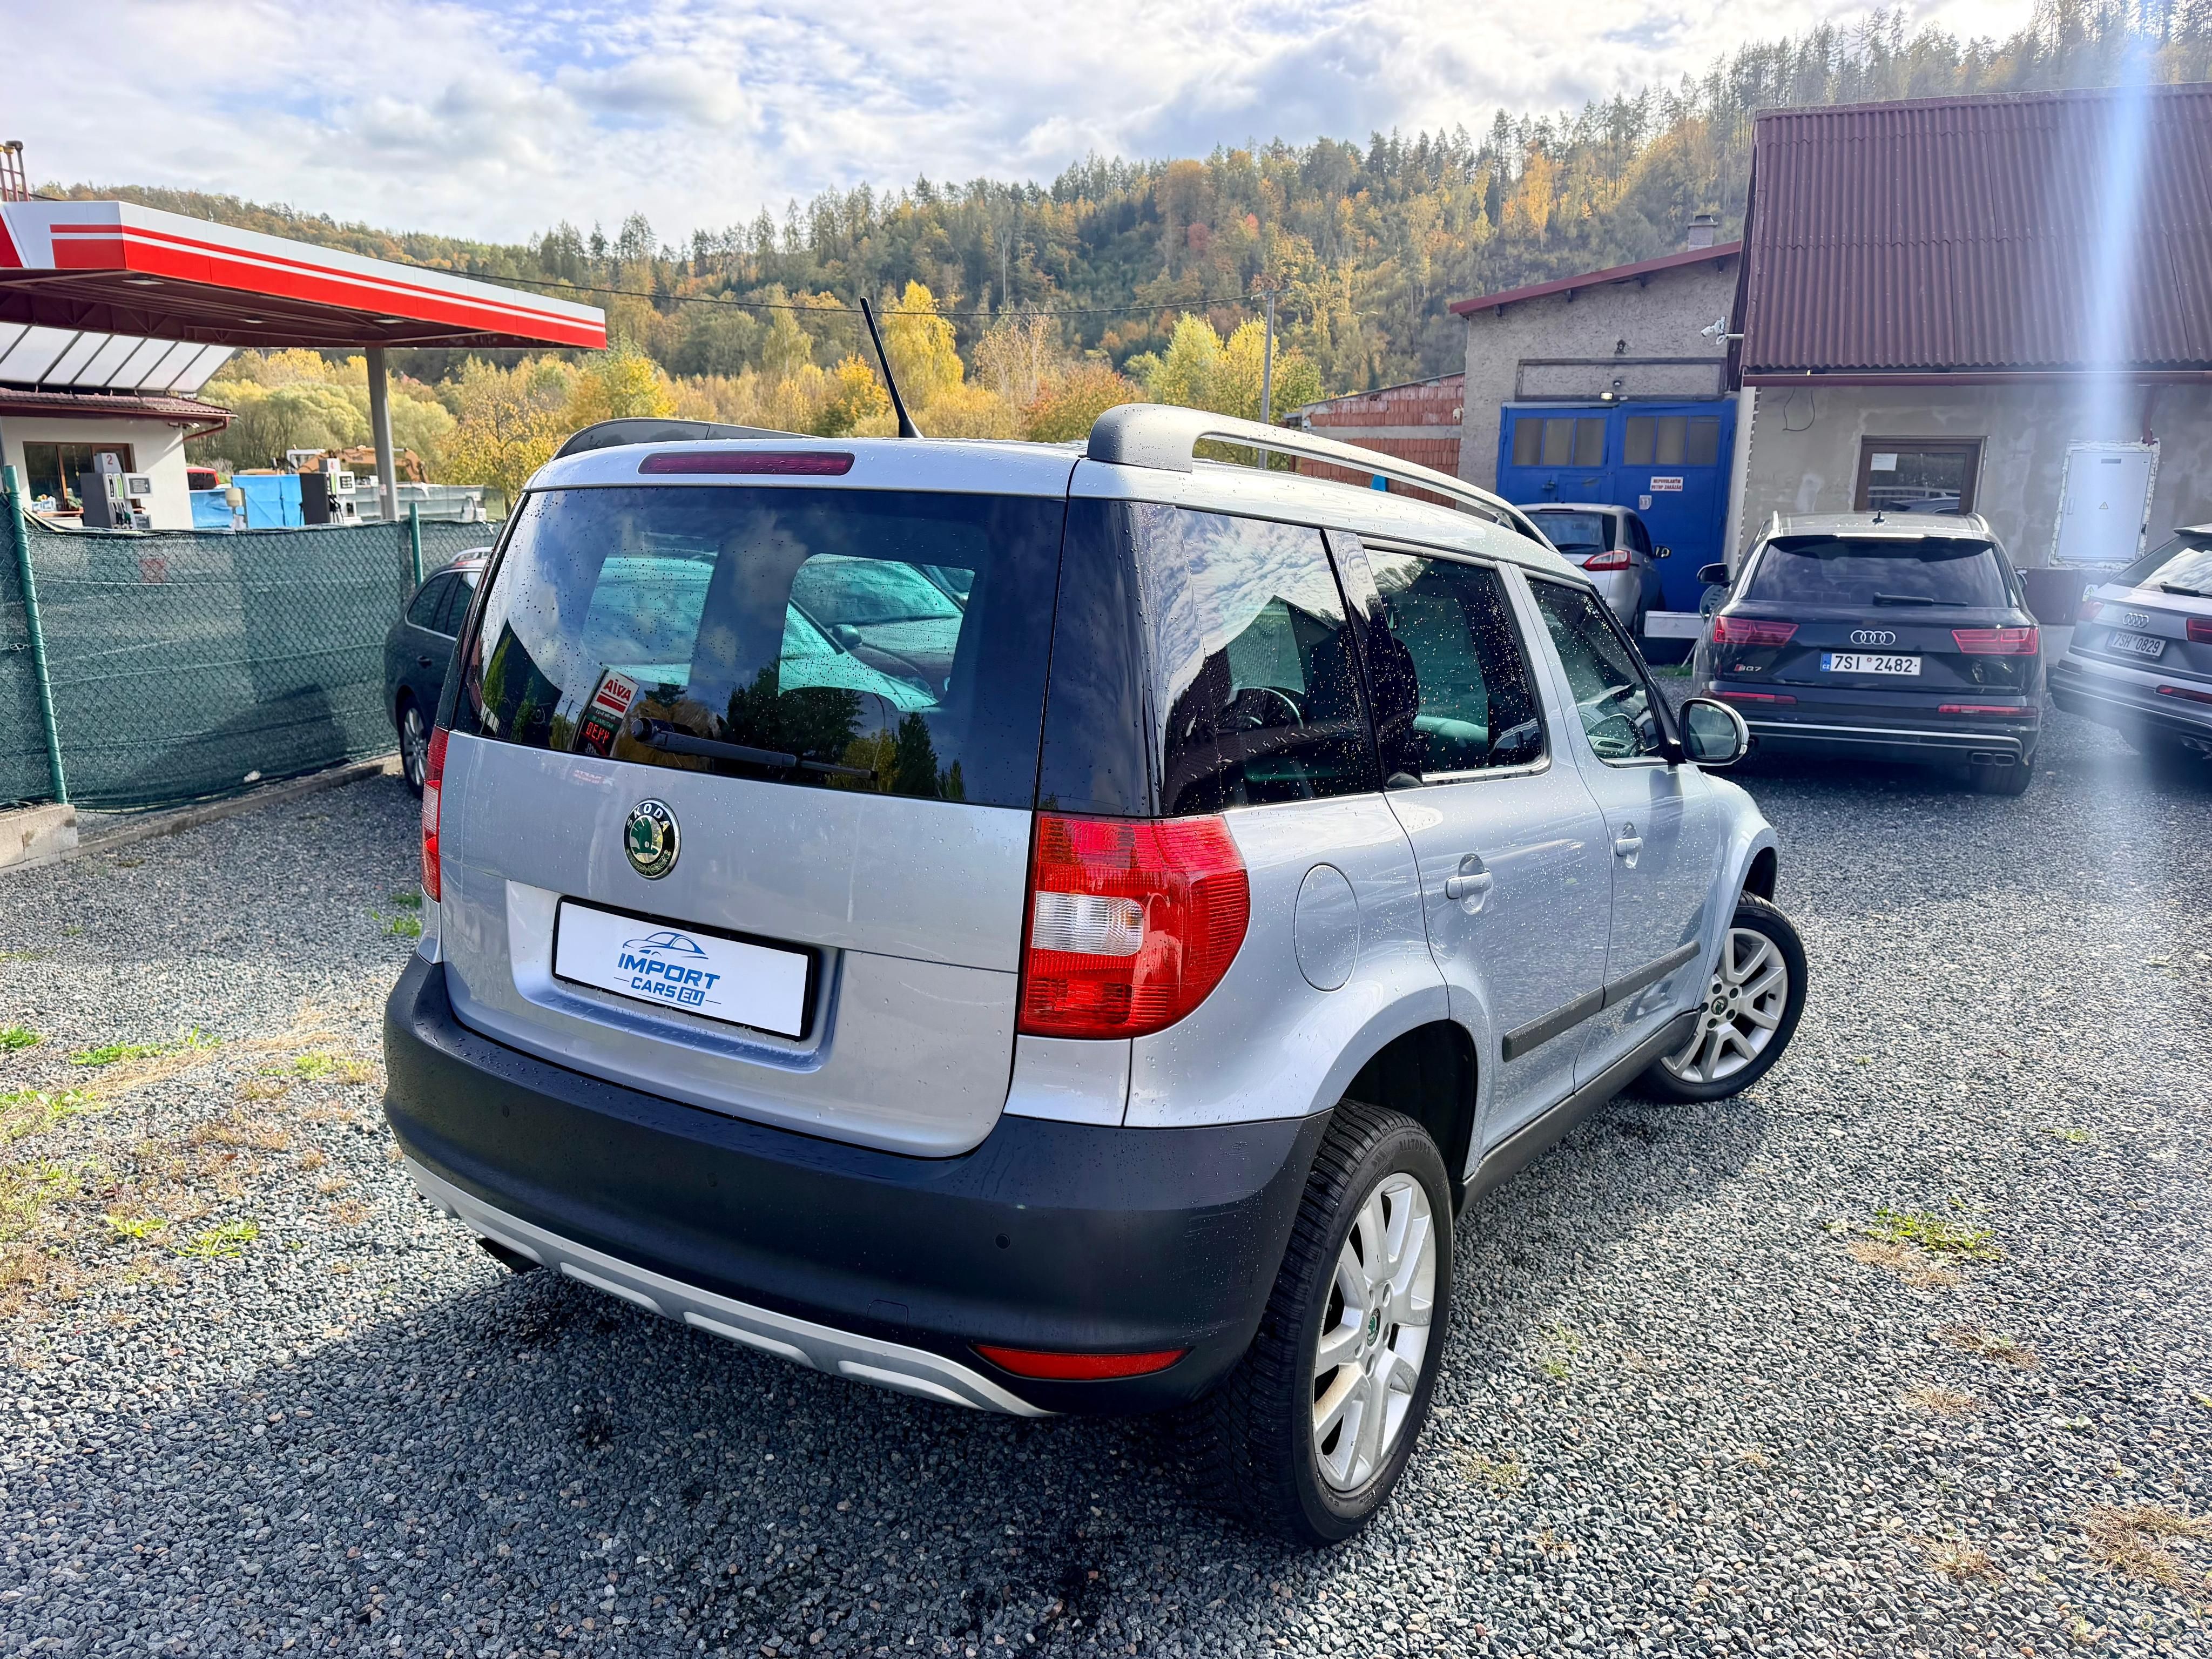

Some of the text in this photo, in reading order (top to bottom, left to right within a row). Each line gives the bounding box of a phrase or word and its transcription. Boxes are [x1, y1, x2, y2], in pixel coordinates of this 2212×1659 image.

[106, 454, 113, 465] 2
[2114, 633, 2133, 648] 7SH
[2135, 638, 2161, 653] 0829
[1835, 655, 1913, 673] 7SI 2482
[617, 953, 721, 989] IMPORT
[631, 976, 704, 1005] CARS EU
